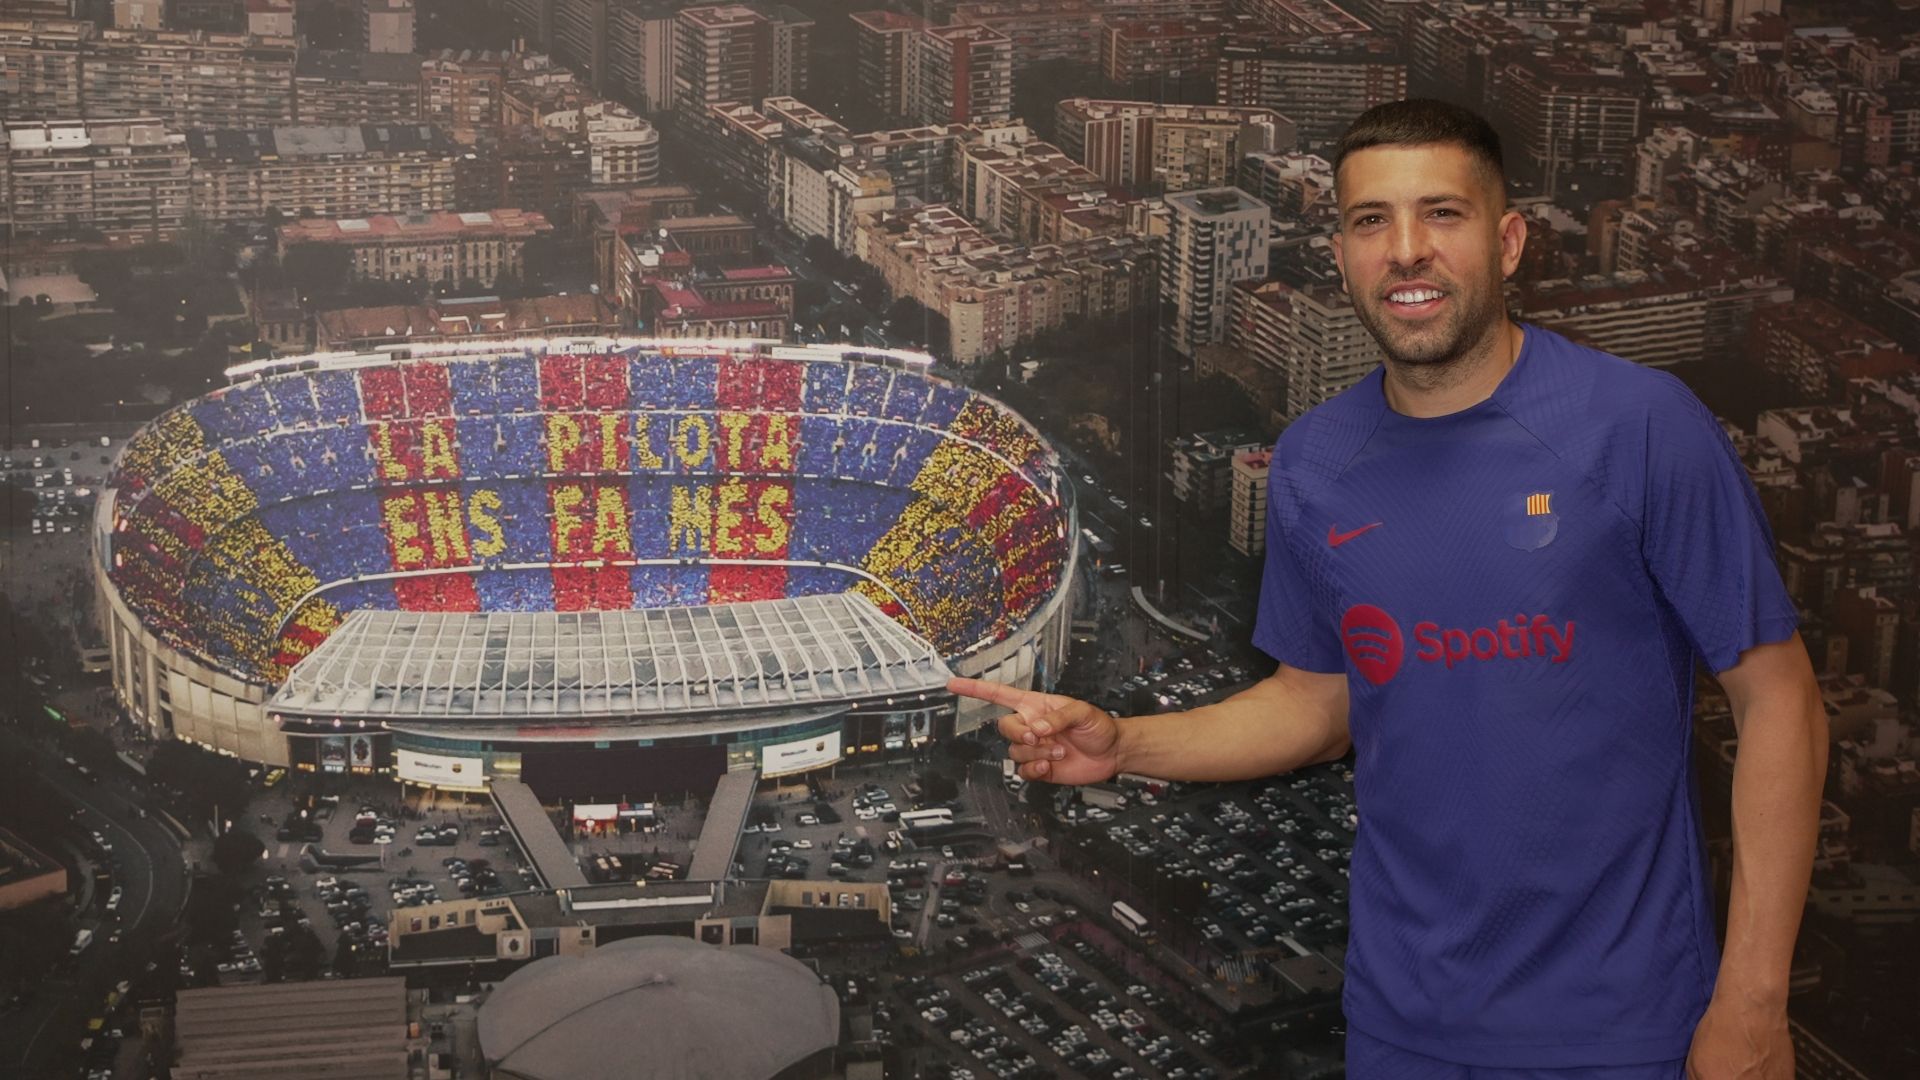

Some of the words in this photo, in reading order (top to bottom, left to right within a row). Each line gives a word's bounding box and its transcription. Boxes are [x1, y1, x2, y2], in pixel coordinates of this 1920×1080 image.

[378, 421, 458, 480] LA
[548, 413, 790, 471] PILOTA
[384, 490, 507, 563] ENS
[553, 485, 630, 553] FA
[1414, 613, 1576, 669] Spotify
